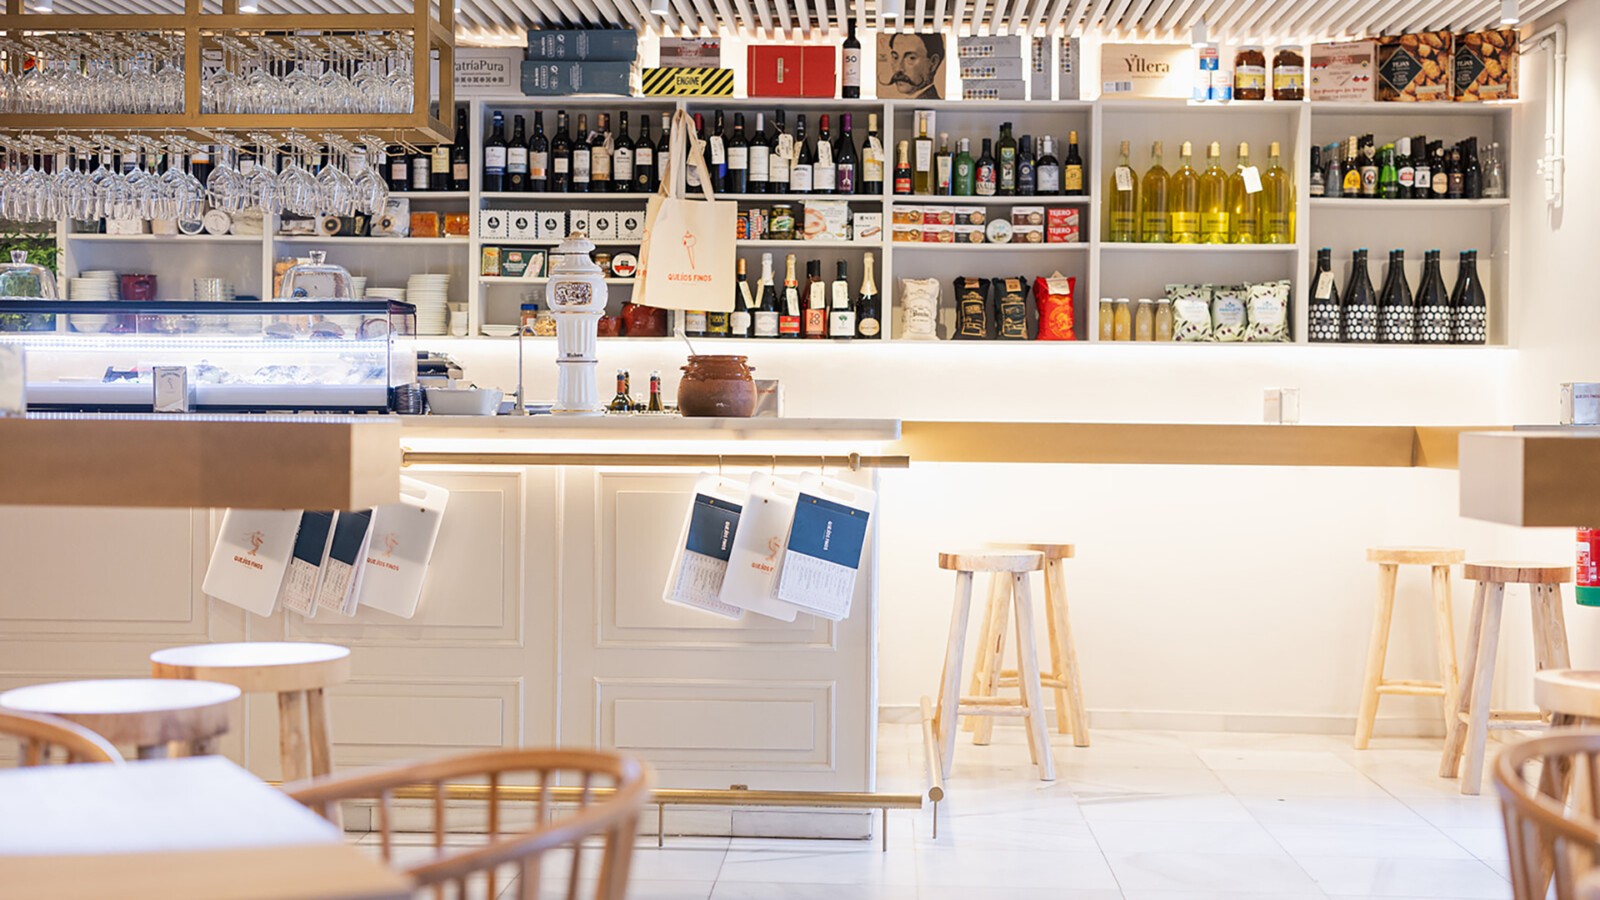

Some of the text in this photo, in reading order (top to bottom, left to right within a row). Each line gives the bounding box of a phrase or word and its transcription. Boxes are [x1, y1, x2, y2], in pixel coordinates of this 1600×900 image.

[846, 55, 857, 63] 50
[1123, 54, 1170, 73] Yllera
[454, 59, 504, 71] atríaPura
[676, 76, 700, 85] ENGINE
[693, 274, 712, 282] FINOS
